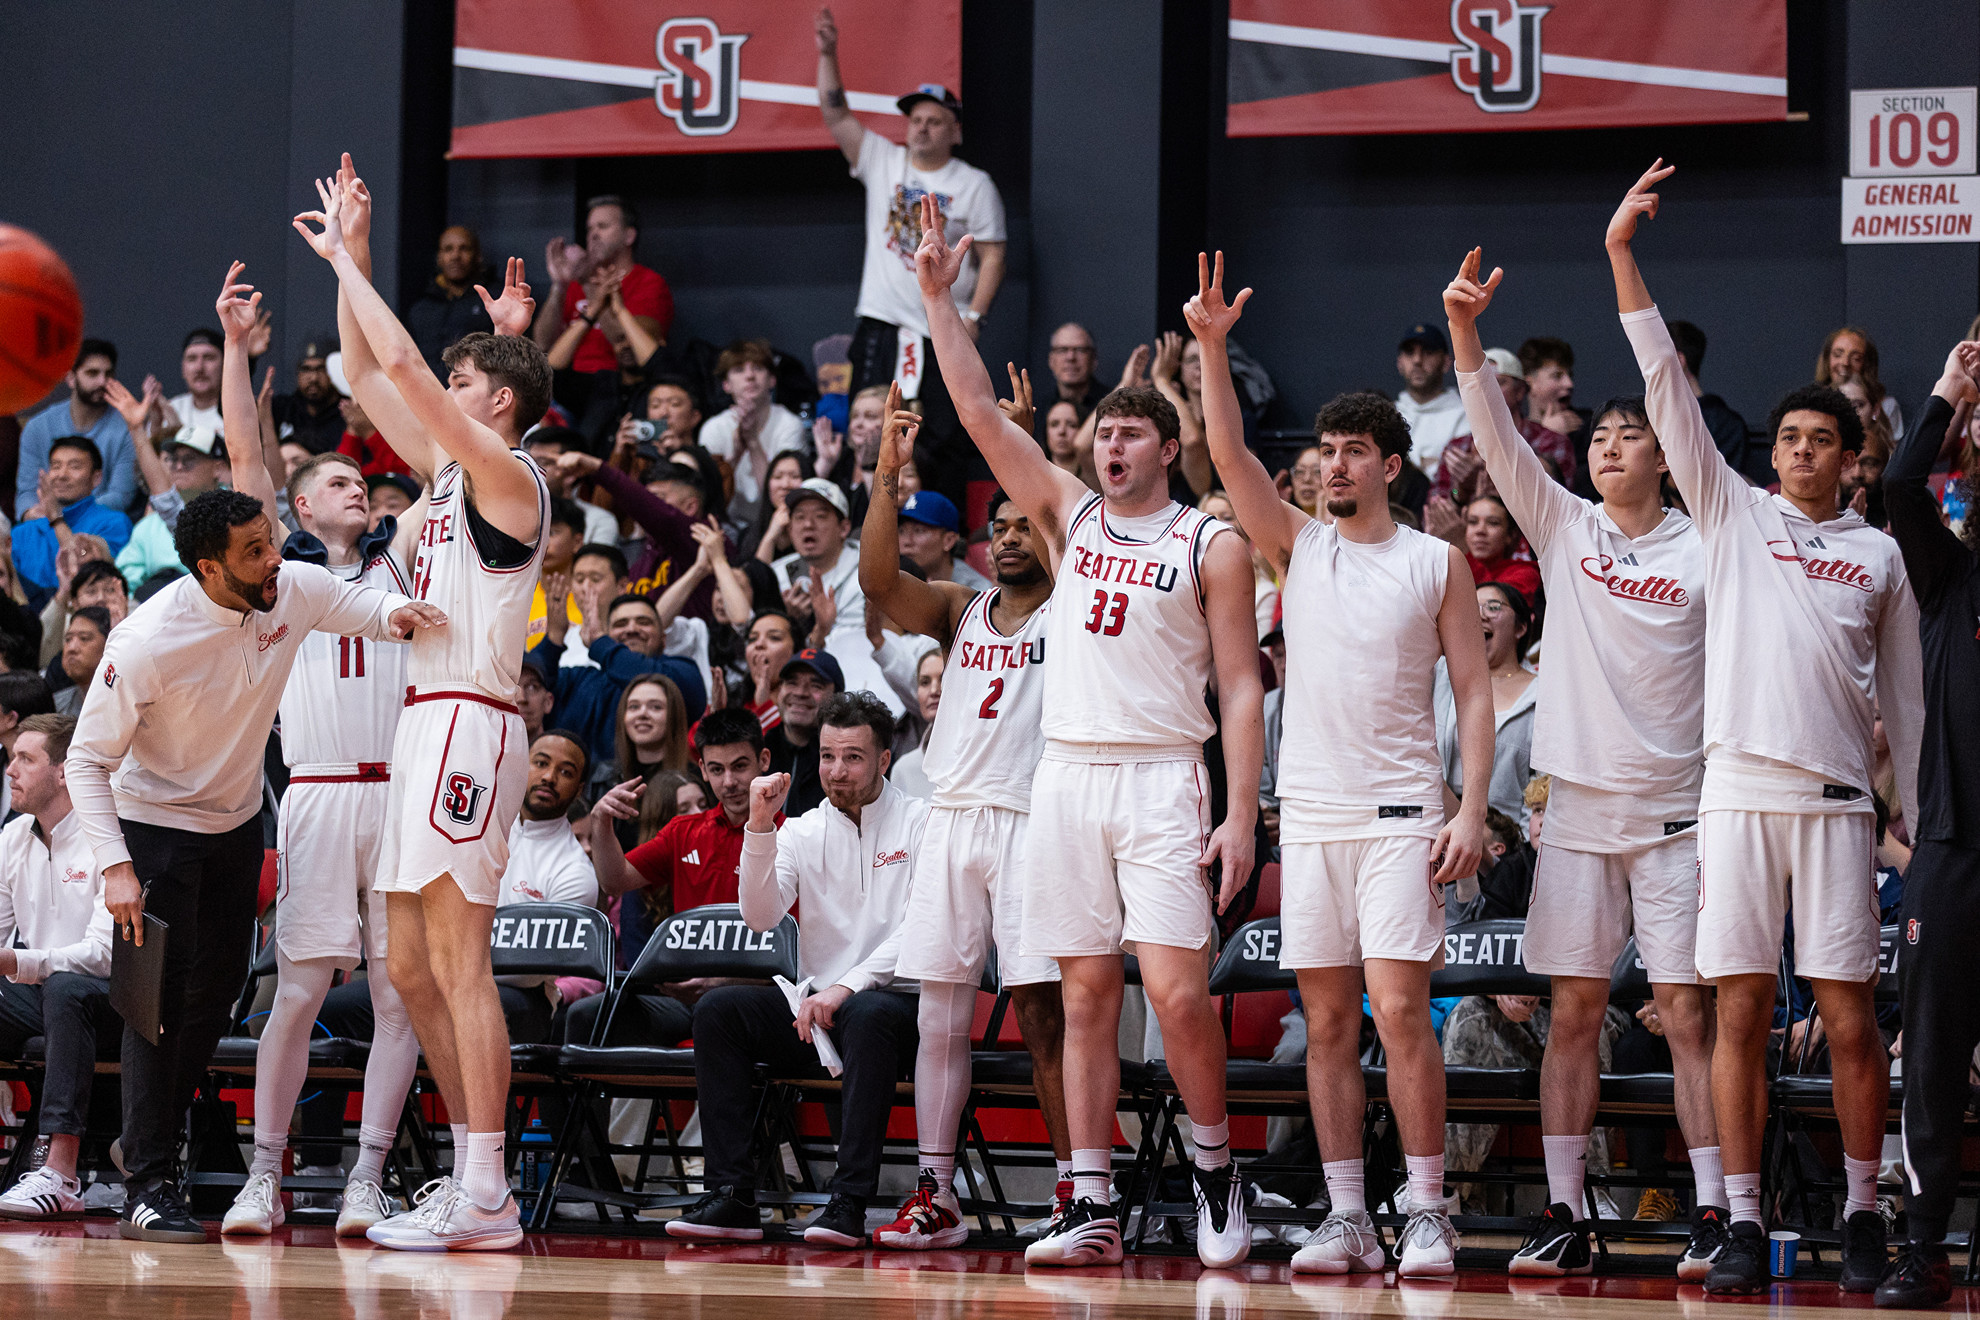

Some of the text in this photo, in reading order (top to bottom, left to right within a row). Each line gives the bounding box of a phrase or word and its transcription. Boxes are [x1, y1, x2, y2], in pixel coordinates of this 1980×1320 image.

[655, 17, 750, 136] SU
[1450, 0, 1553, 113] SU
[1882, 96, 1946, 113] SECTION
[1868, 111, 1960, 169] 109
[1865, 183, 1961, 206] GENERAL
[1851, 214, 1973, 237] ADMISSION
[1580, 553, 1690, 607] Seattle
[1084, 589, 1130, 638] 33
[337, 635, 366, 679] 11
[800, 648, 817, 660] C
[978, 677, 1005, 720] 2
[442, 771, 488, 826] SU
[872, 849, 910, 868] Seattle
